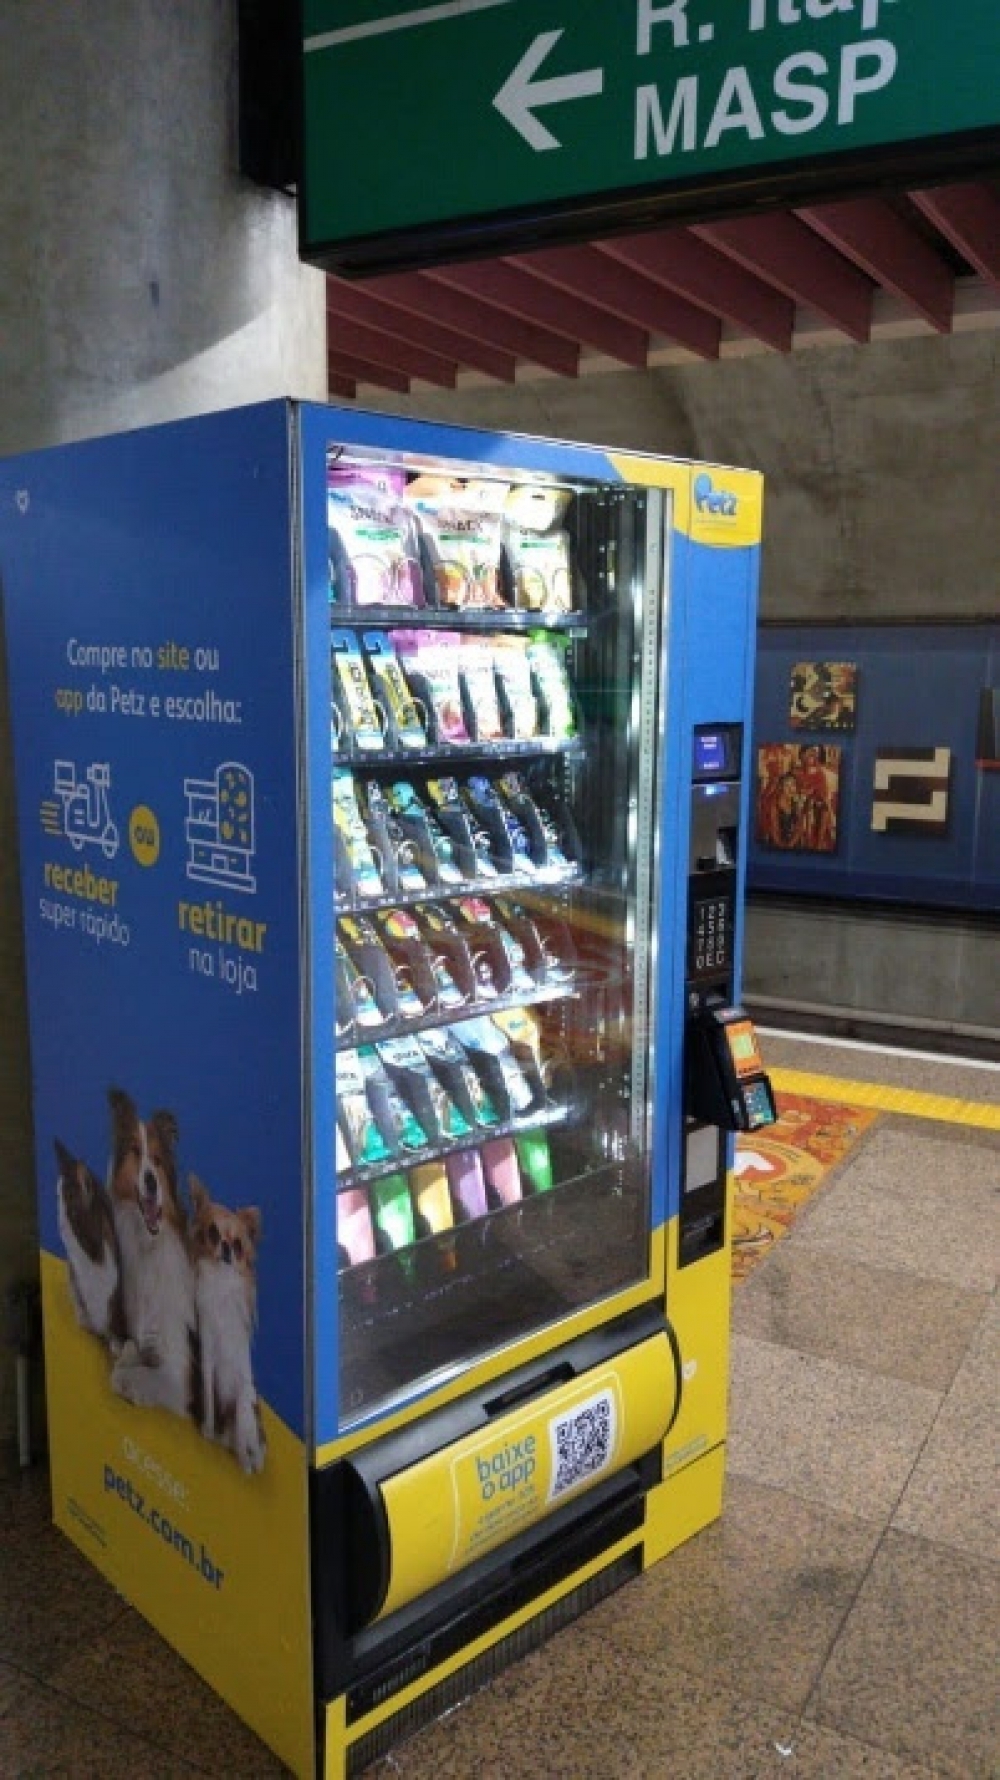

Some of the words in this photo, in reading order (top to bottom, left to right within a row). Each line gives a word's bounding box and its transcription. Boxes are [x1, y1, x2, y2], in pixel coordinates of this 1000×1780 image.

[633, 39, 898, 160] MASP
[67, 638, 127, 674] Compre
[131, 646, 153, 669] no
[157, 641, 190, 670] site
[194, 646, 220, 670] ou
[55, 688, 83, 717] app
[86, 684, 107, 712] da
[111, 685, 145, 716] Petz
[150, 696, 160, 716] e
[164, 690, 243, 723] escolha:
[133, 824, 155, 846] ou
[44, 863, 119, 907] receber
[39, 898, 76, 930] super
[79, 904, 131, 947] rápido
[178, 901, 267, 953] retirar
[189, 948, 215, 977] na
[219, 948, 258, 994] loja
[475, 1434, 536, 1481] baixe
[482, 1481, 496, 1500] o
[500, 1458, 536, 1491] app
[104, 1464, 224, 1589] petz.com.br
